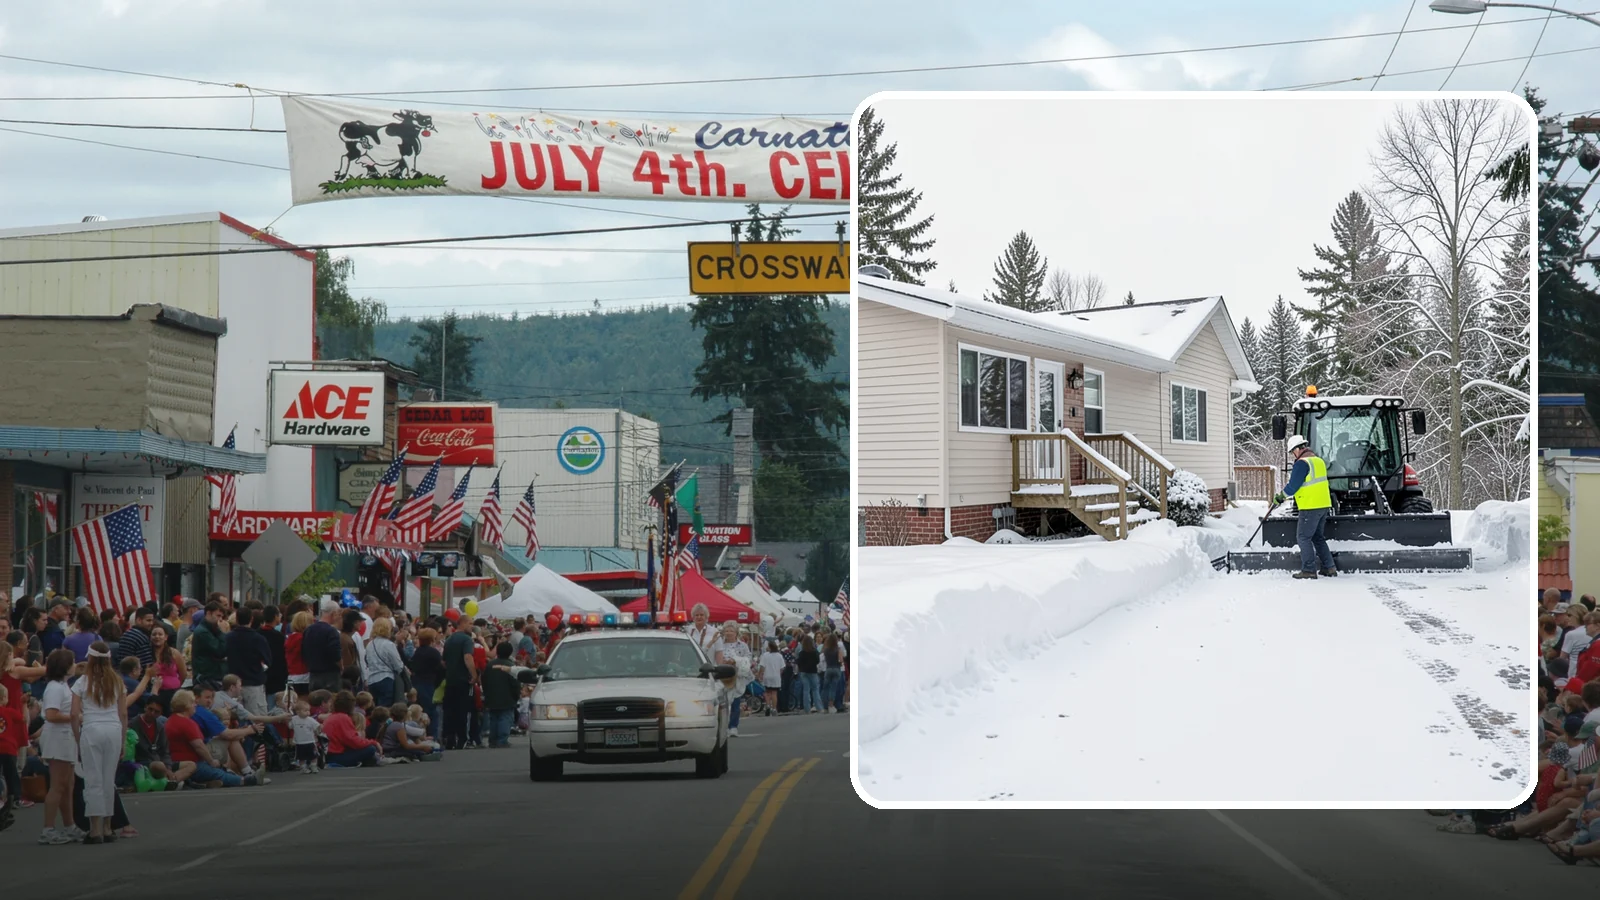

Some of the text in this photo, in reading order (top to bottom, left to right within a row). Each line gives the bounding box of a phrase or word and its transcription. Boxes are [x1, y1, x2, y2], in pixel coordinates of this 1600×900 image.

[695, 121, 850, 150] Carnat
[481, 141, 604, 193] JULY
[632, 150, 747, 198] 4th.
[697, 253, 850, 280] CROSSWA
[283, 380, 373, 420] ACE
[405, 409, 453, 422] CEDAR
[283, 421, 371, 437] Hardware
[416, 427, 477, 447] Coca-Cola
[353, 467, 385, 479] Simpl
[83, 485, 155, 495] St. Vincent de Paul
[688, 526, 741, 535] CRNATION
[699, 535, 730, 543] GLASS
